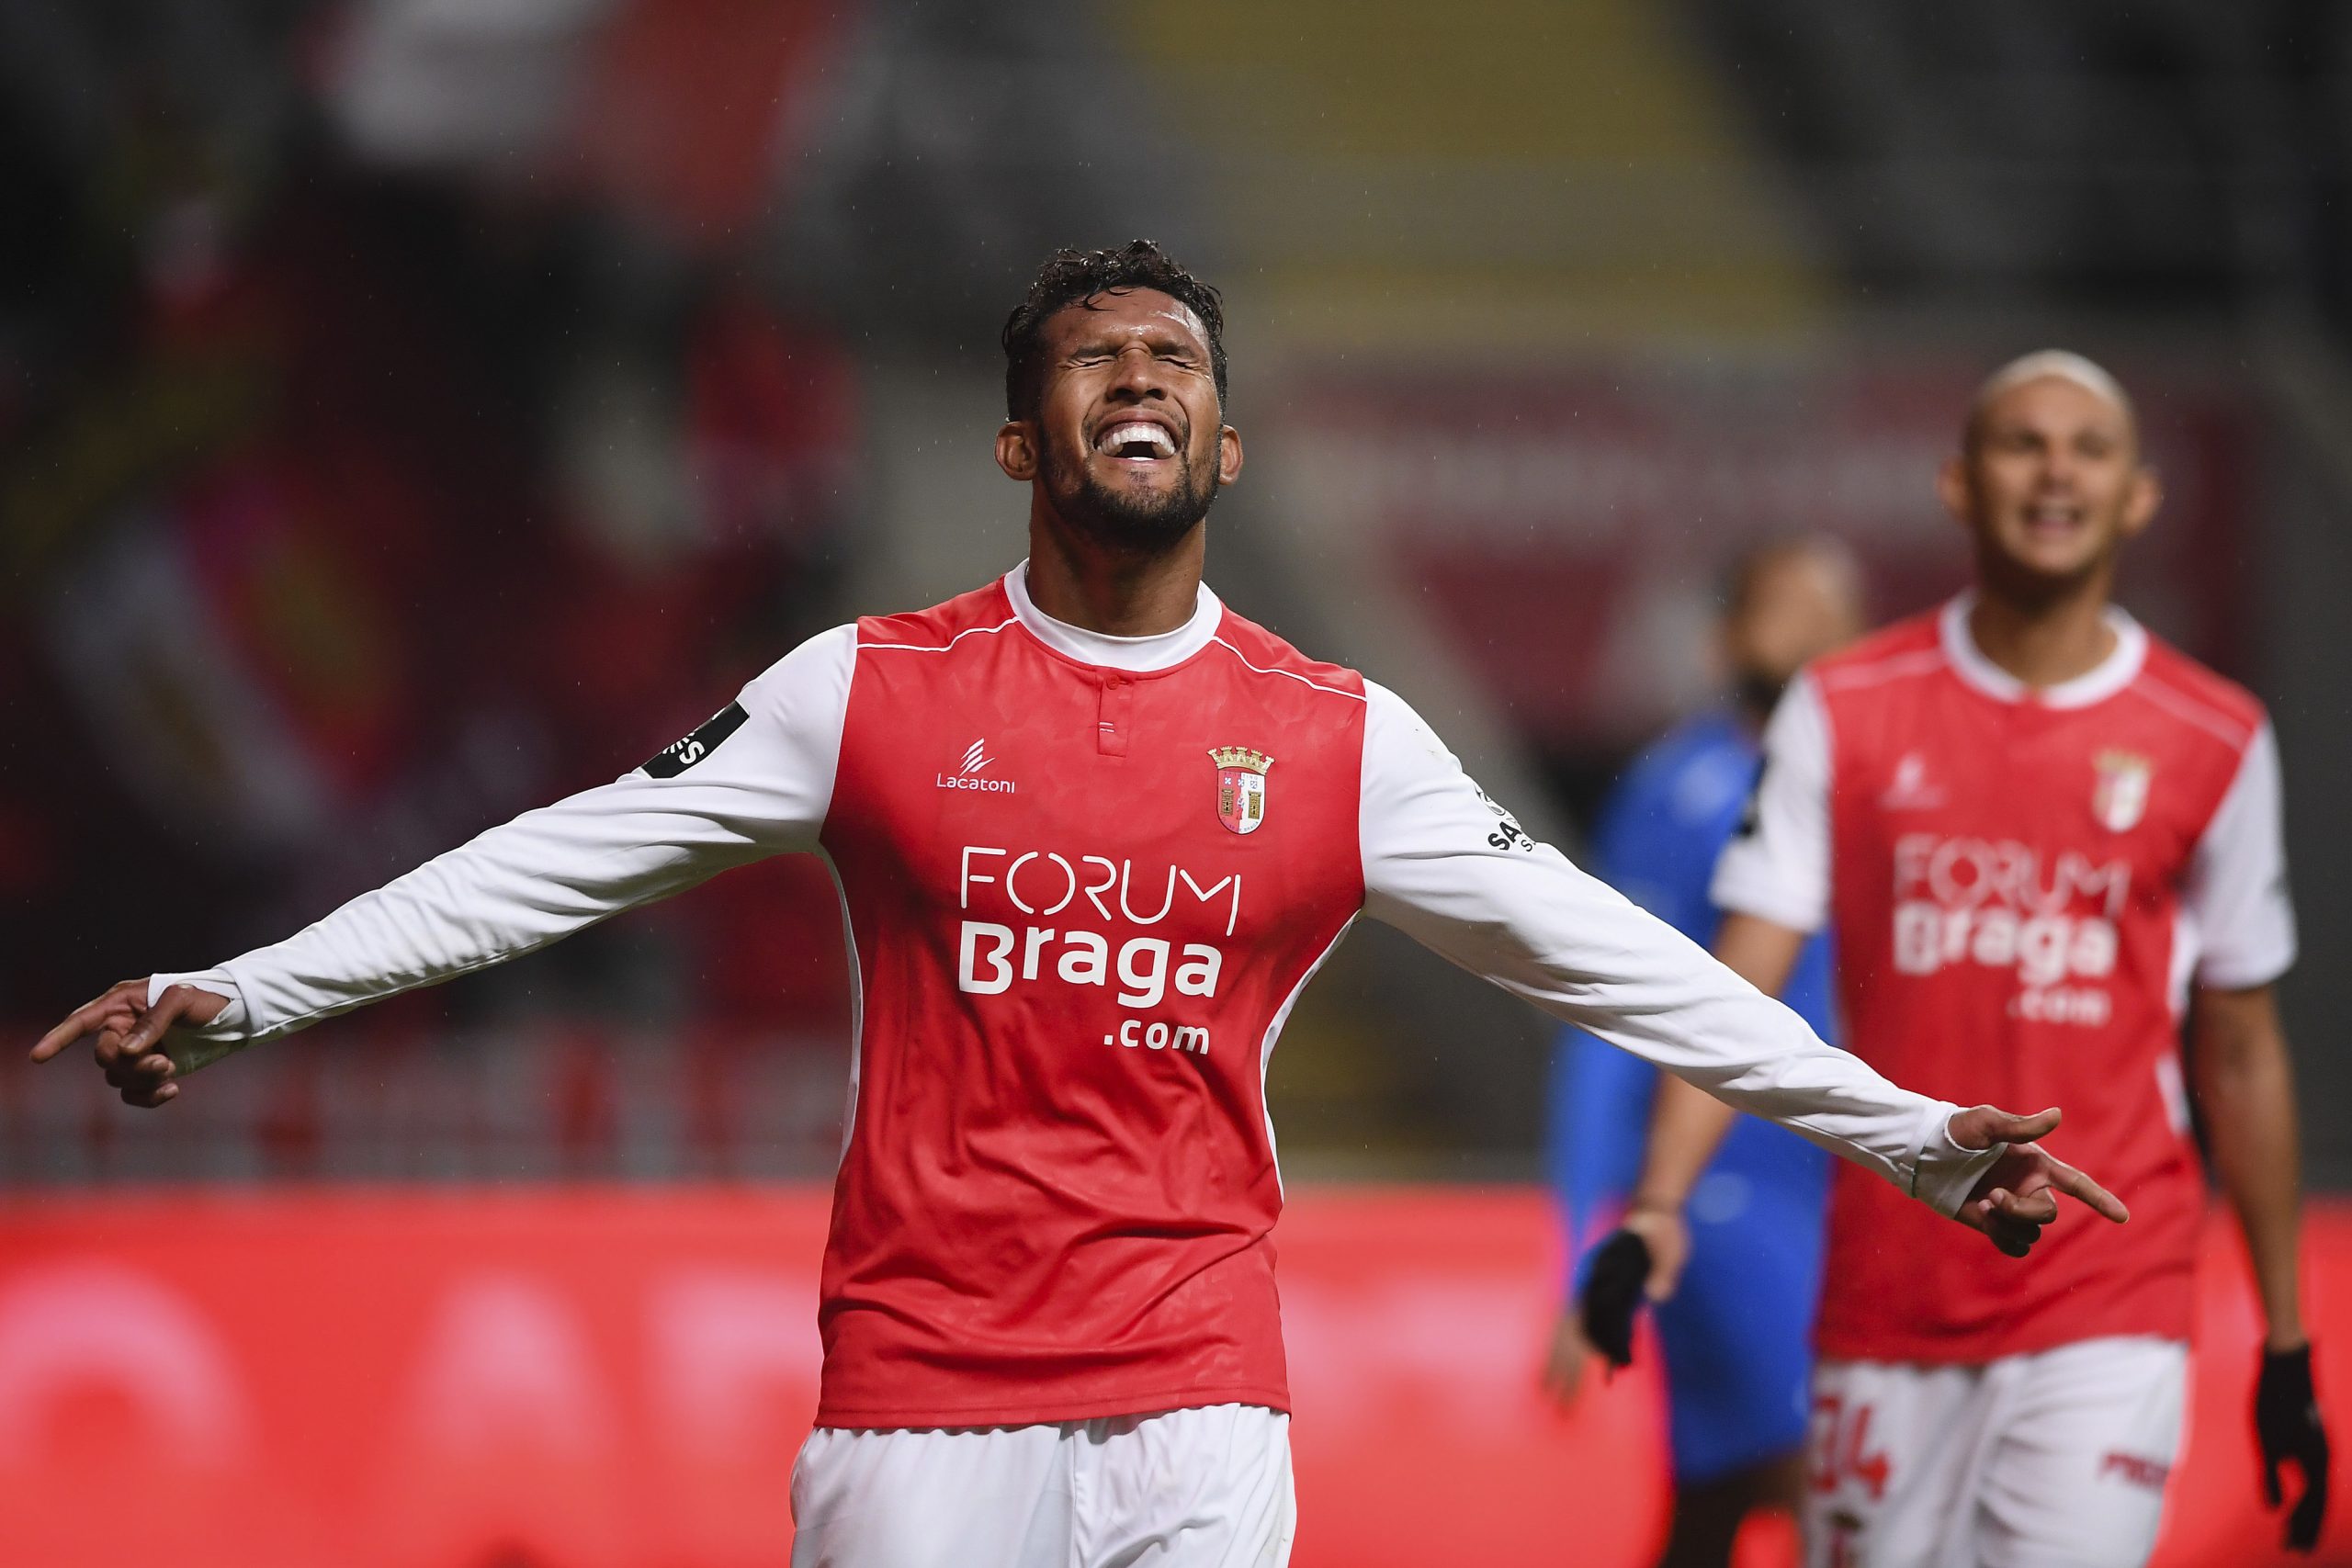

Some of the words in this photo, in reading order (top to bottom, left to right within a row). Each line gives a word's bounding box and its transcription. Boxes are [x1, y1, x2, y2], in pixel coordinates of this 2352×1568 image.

[936, 773, 1015, 794] Lacatoni
[961, 845, 1241, 937] FORUM
[1894, 832, 2132, 919] FORUM
[958, 919, 1223, 1009] Braga
[1894, 900, 2119, 986] Braga
[1103, 1019, 1210, 1055] .com
